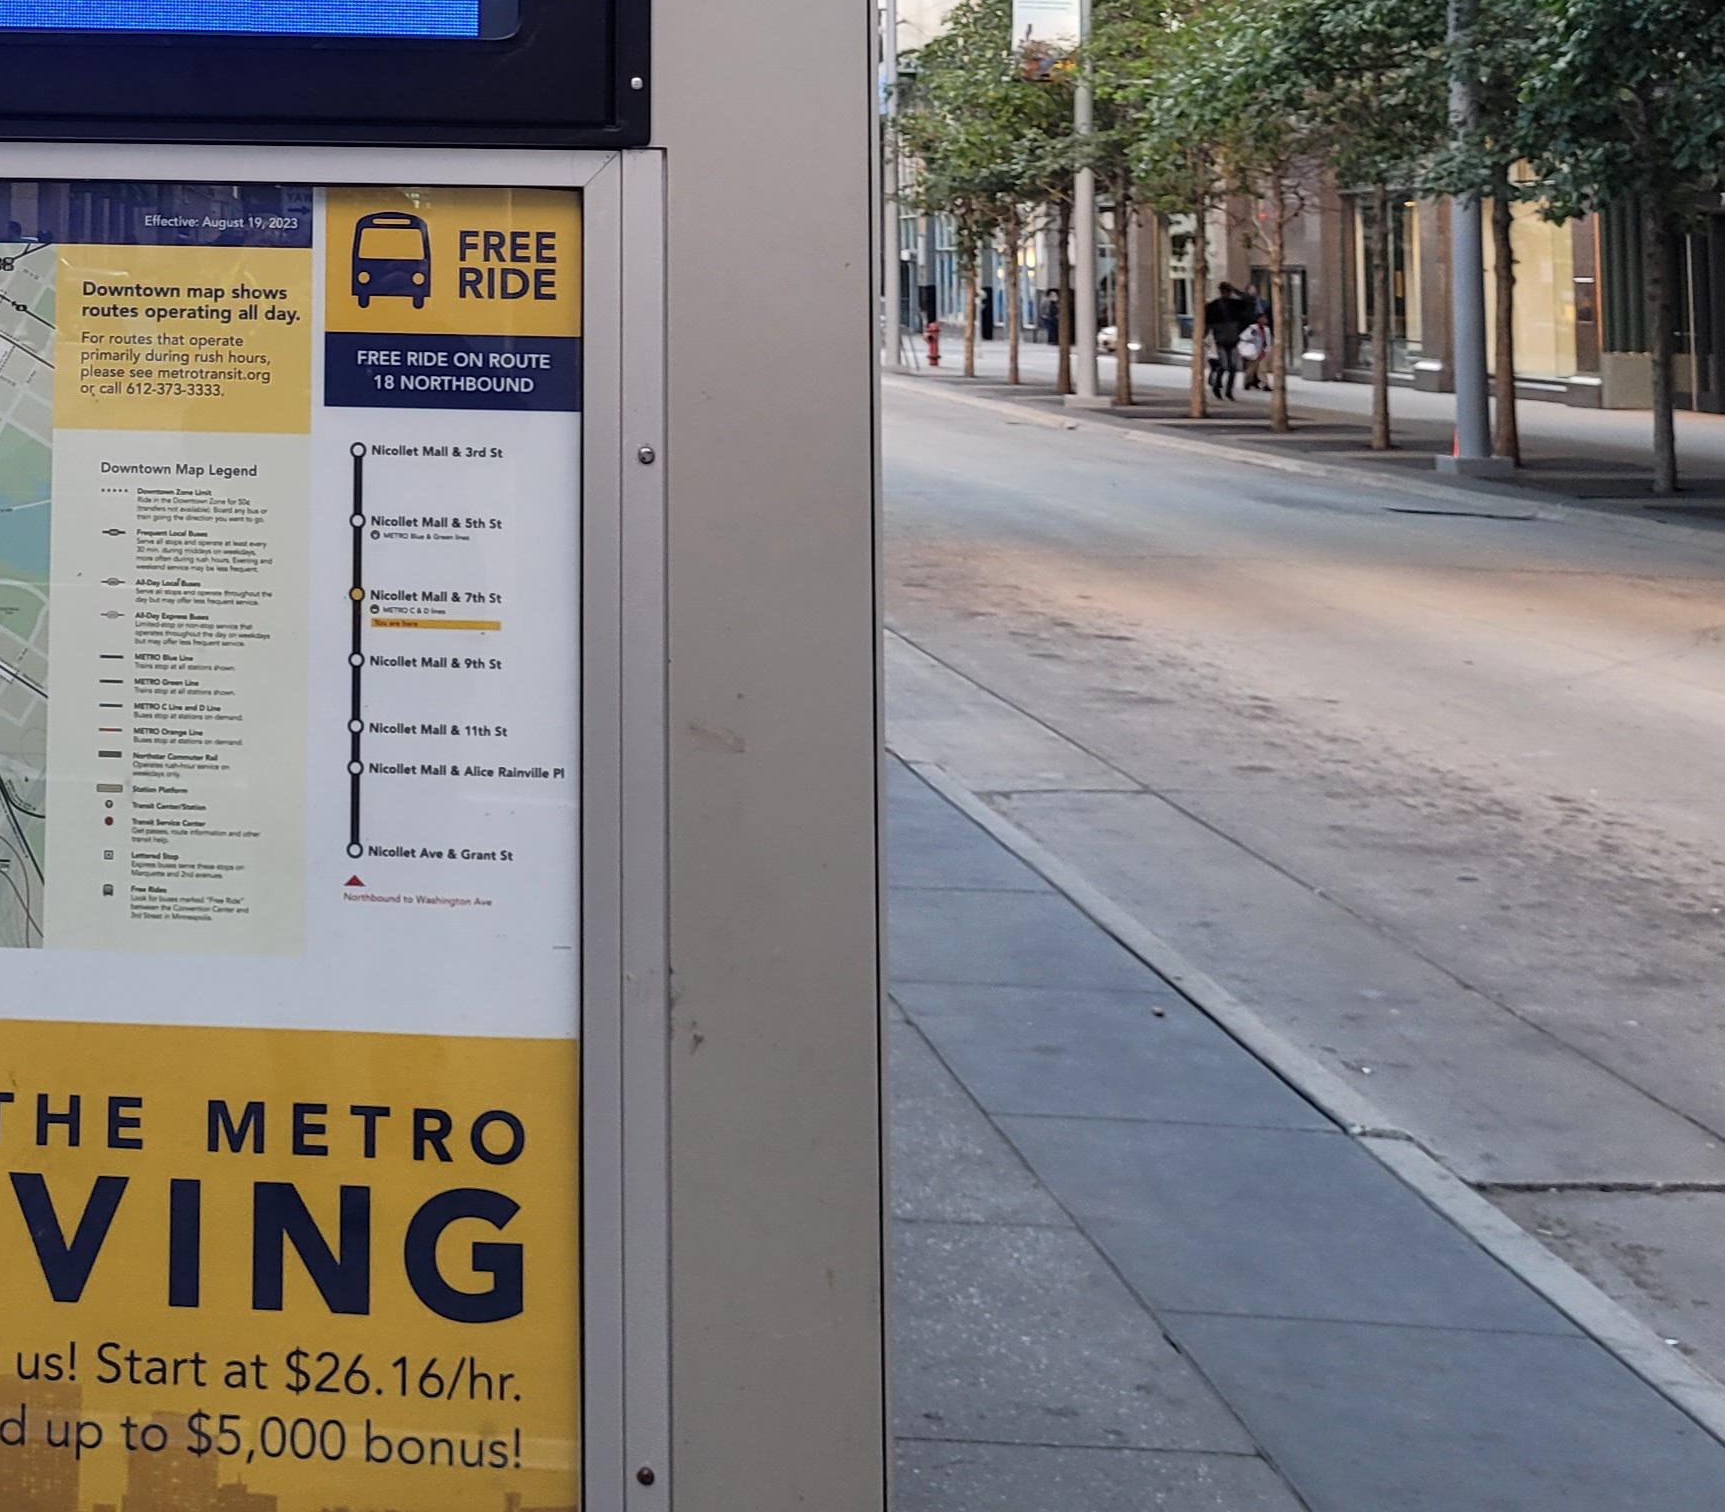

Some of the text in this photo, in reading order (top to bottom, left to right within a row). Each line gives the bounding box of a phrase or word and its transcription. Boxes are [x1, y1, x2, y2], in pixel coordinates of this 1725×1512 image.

[144, 214, 298, 231] Effective: August 19, 2023
[460, 230, 556, 263] FREE
[82, 280, 288, 303] Downtown map shows
[459, 267, 556, 300] RIDE
[81, 303, 300, 326] routes operating all day.
[81, 330, 244, 353] For routes that operate
[80, 347, 271, 368] primarily during rush hours,
[357, 349, 550, 369] FREE RIDE ON ROUTE
[80, 364, 271, 386] please see metrotransit.org
[373, 374, 534, 393] 18 NORTHBOUND
[79, 381, 225, 397] or call 612-373-3333.
[371, 444, 503, 459] Nicollet Mall & 3rd St
[100, 461, 257, 480] Downtown Map Legend
[136, 487, 175, 495] Downtown
[175, 487, 193, 496] Zone
[370, 515, 502, 529] Nicollet Mall & 5th St
[135, 528, 208, 538] Frequent Local Buses
[134, 578, 201, 588] All-Day Local Buses
[369, 589, 501, 604] Nicollet Mall & 7th St
[134, 611, 209, 621] All-Day Express Buses
[133, 652, 194, 662] METRO Blue Line
[369, 655, 501, 670] Nicollet Mall & 9th St
[133, 677, 199, 687] METRO Green Line
[368, 722, 507, 737] Nicollet Mall & 11th St
[368, 762, 565, 779] Nicollet Mall & Alice Rainville Pl
[367, 845, 513, 861] Nicollet Ave & Grant St
[129, 884, 167, 894] Free Rides
[343, 891, 492, 908] Northbound to Washington Ave
[208, 1100, 524, 1165] METRO
[17, 1341, 74, 1381] us!
[97, 1342, 206, 1386] Start
[224, 1355, 266, 1389] at
[286, 1347, 520, 1401] $26.16/hr.
[47, 1420, 102, 1461] up
[120, 1416, 167, 1451] to
[187, 1409, 345, 1463] $5,000
[366, 1419, 519, 1468] bonus!
